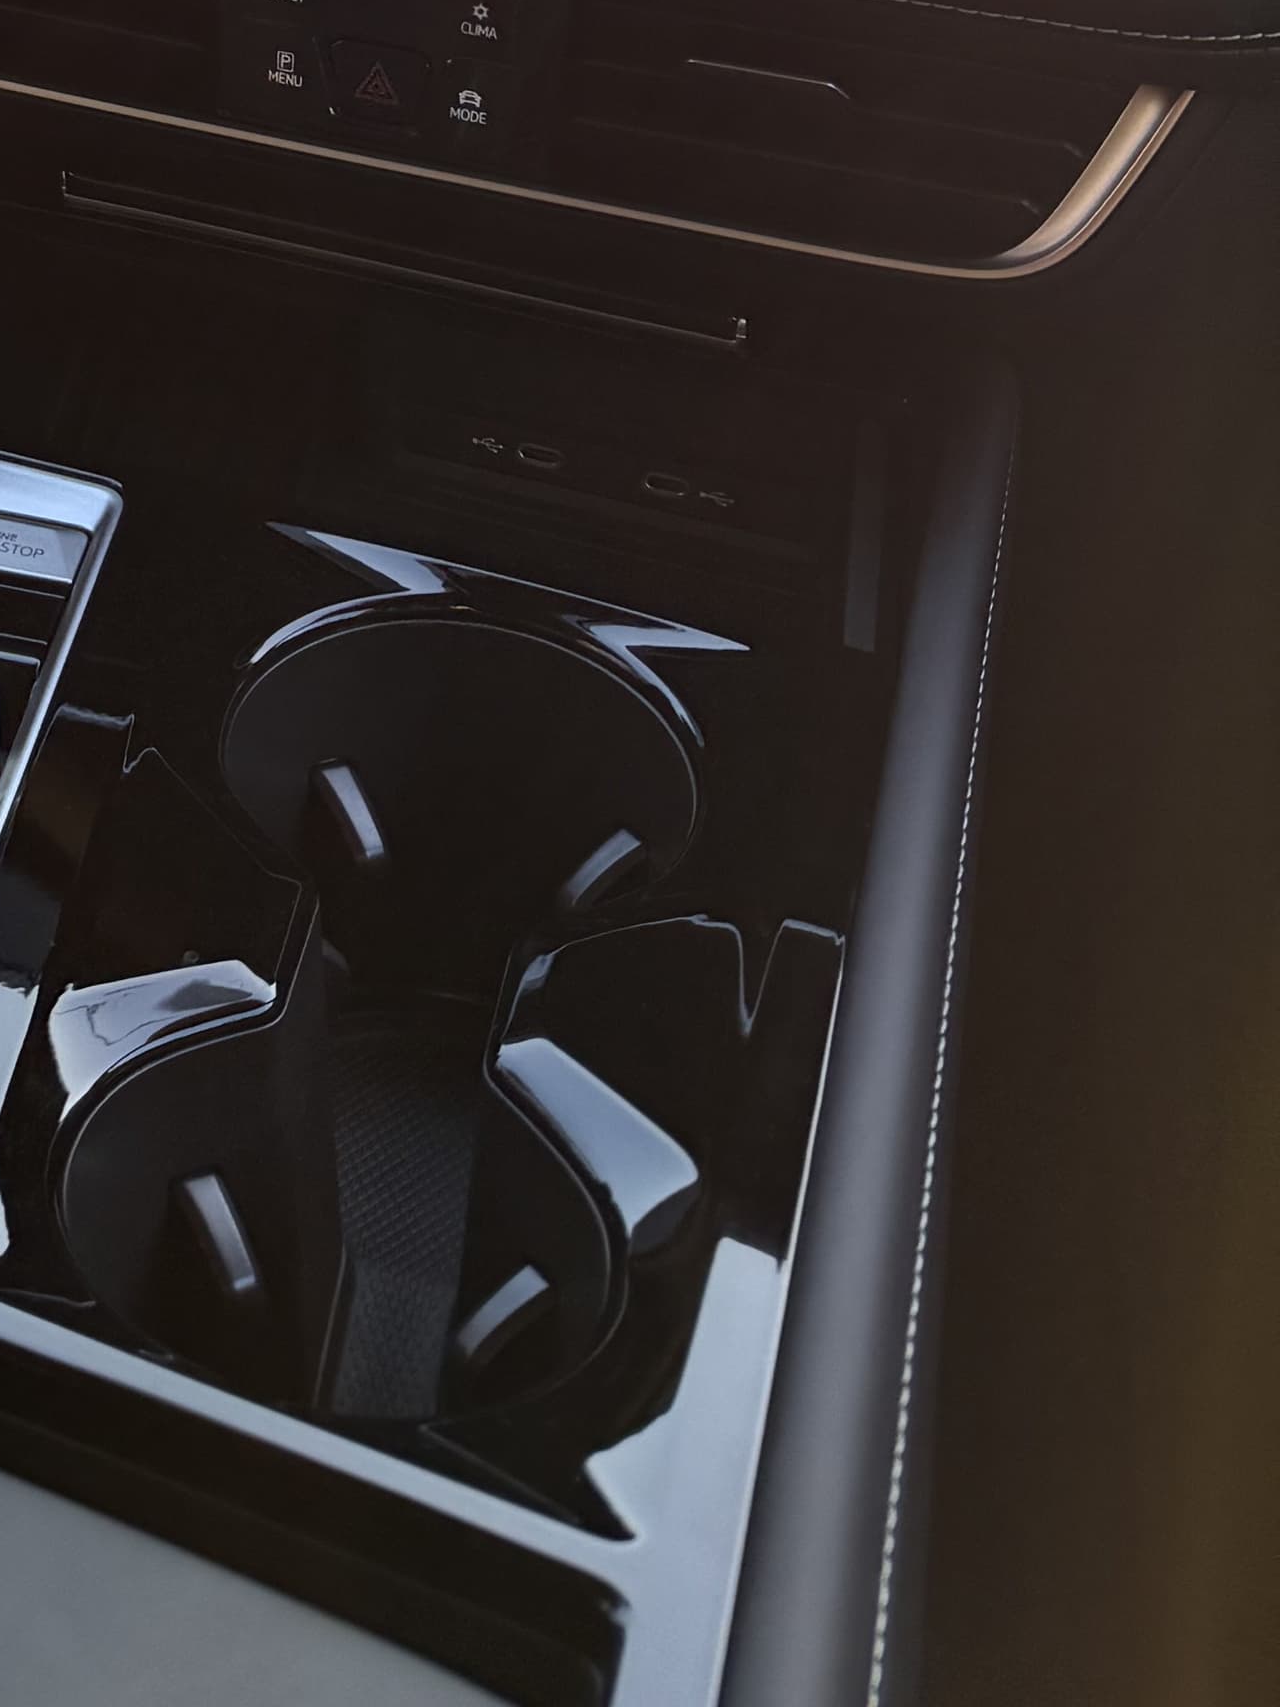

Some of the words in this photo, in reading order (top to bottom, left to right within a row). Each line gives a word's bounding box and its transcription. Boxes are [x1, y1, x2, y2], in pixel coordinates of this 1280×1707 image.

[460, 21, 498, 41] CLIMA
[268, 69, 303, 87] MENU
[449, 106, 488, 125] MODE
